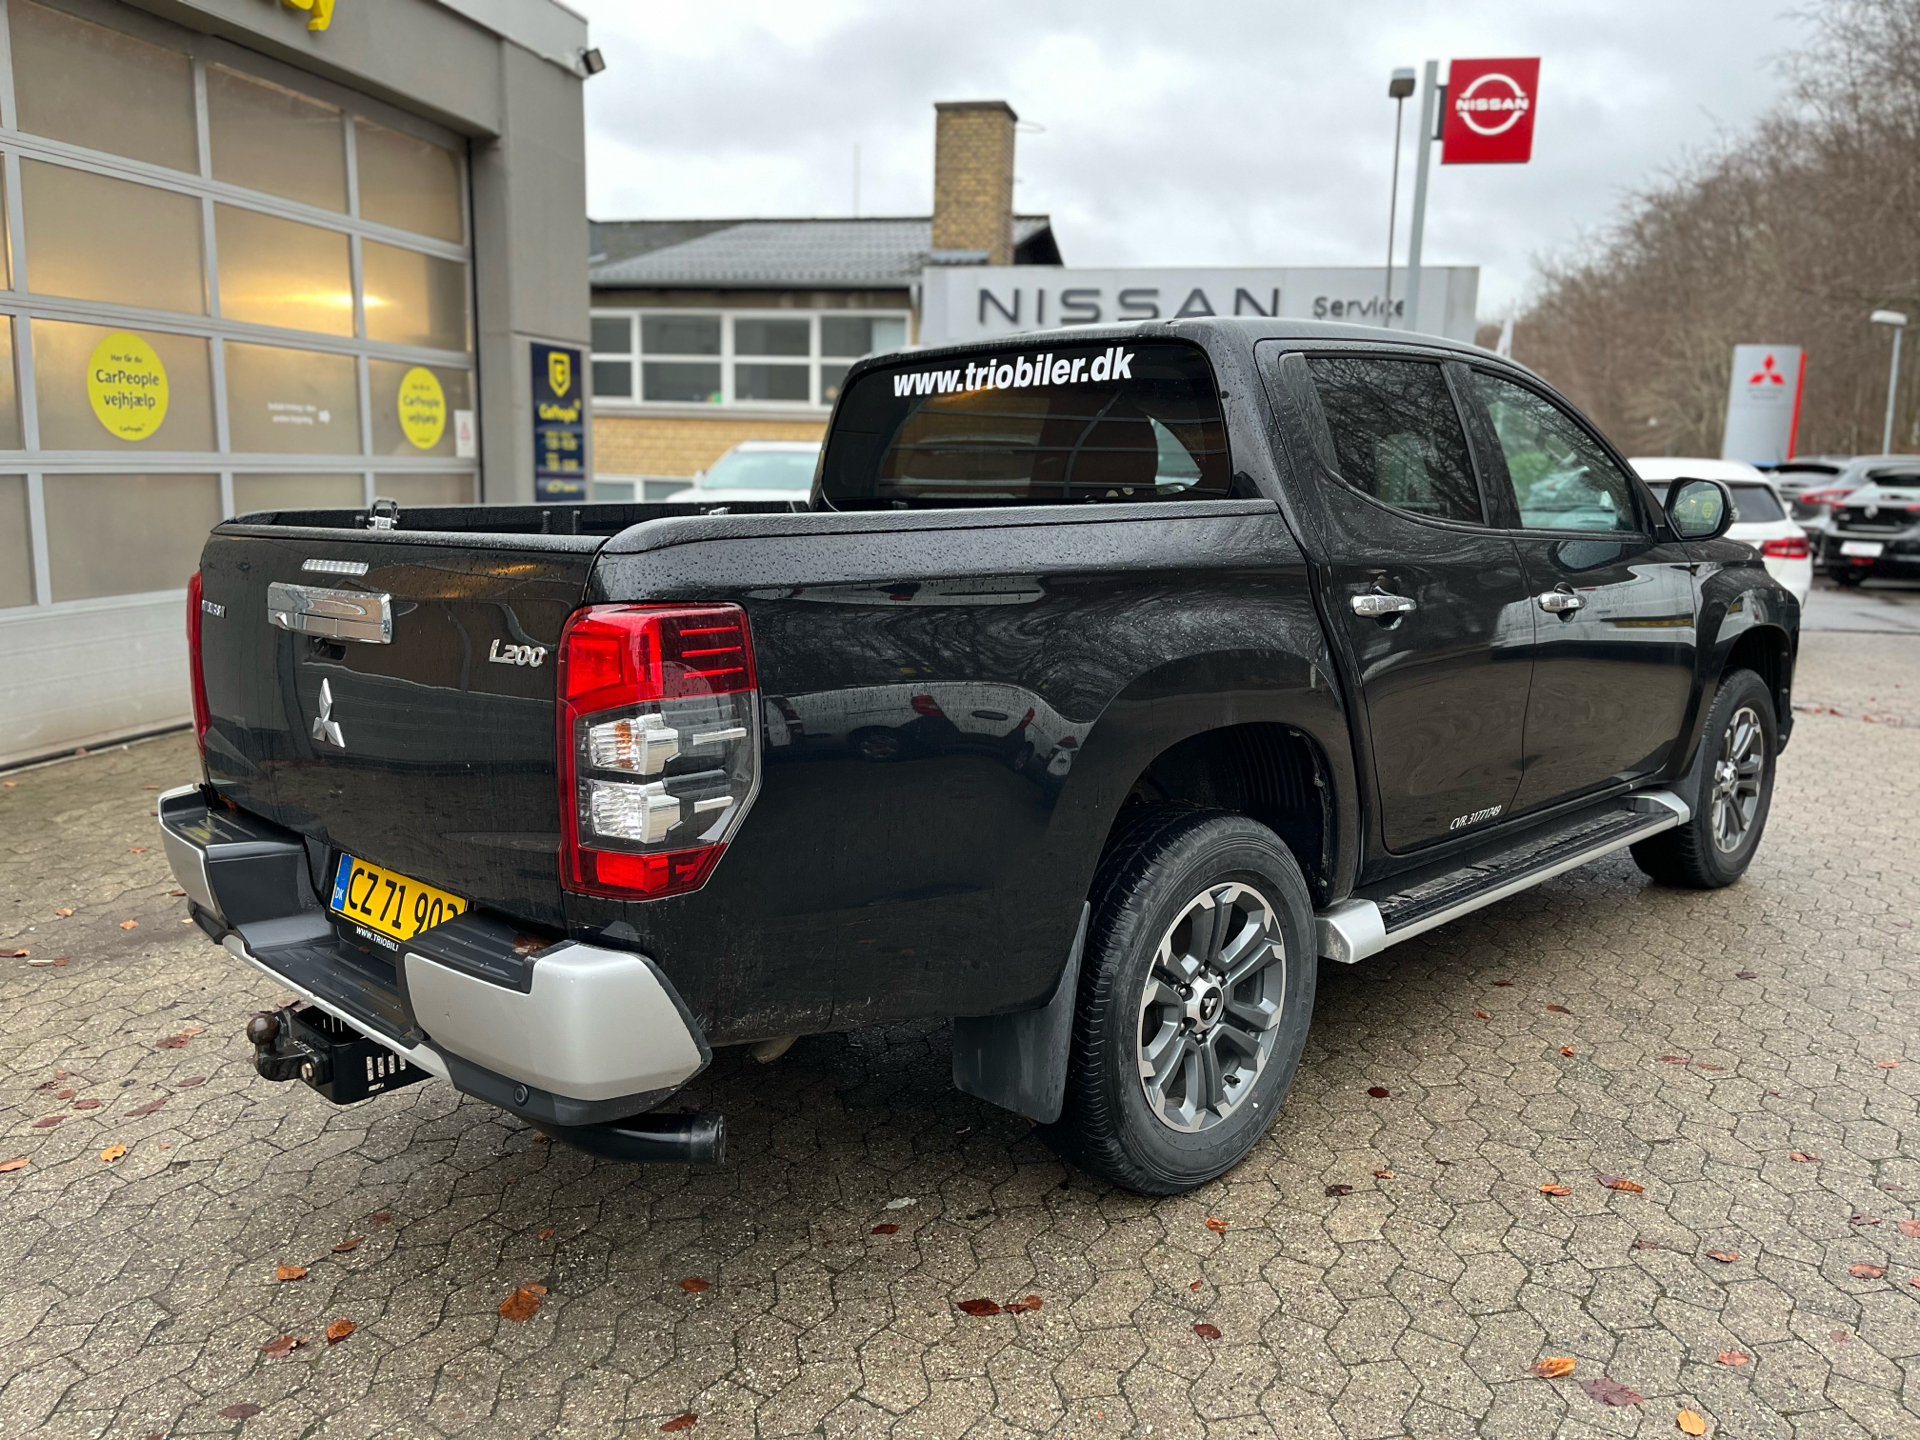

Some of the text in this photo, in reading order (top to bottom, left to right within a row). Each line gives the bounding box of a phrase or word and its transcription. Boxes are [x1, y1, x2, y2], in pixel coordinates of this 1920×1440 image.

[1455, 97, 1529, 111] NISSAN
[978, 287, 1405, 325] NISSAN Service
[96, 368, 160, 389] CarPeople
[893, 346, 1136, 397] www.triobiler.dk
[103, 391, 156, 410] vejhjælp
[489, 639, 546, 667] L200
[334, 886, 345, 901] DK
[348, 867, 379, 917] CZ
[379, 878, 407, 931] 71
[356, 925, 400, 952] WWW.TRIOBIL
